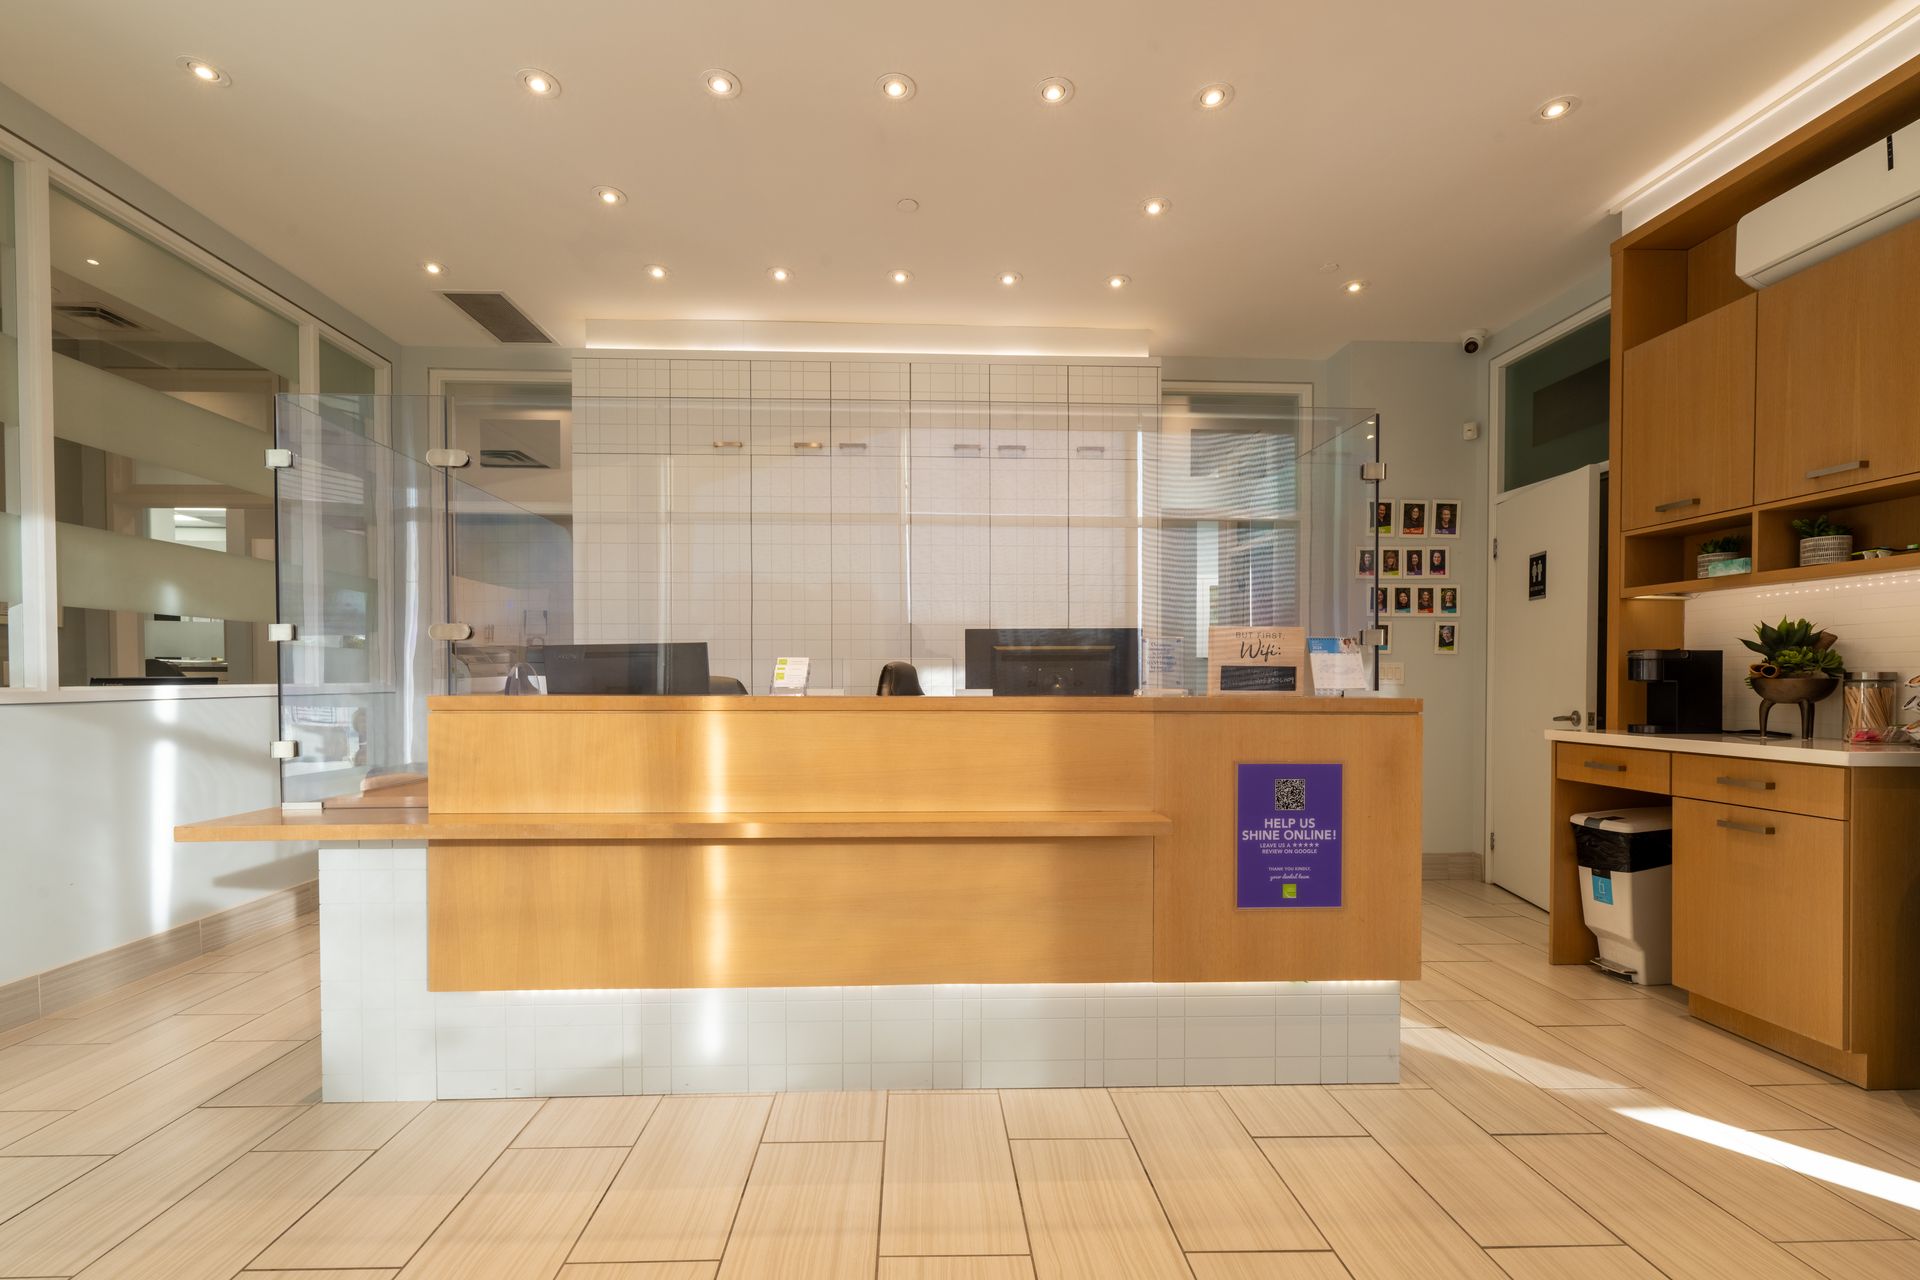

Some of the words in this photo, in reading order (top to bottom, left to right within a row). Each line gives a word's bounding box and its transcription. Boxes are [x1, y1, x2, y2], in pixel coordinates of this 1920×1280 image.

[1235, 631, 1253, 639] BUT
[1240, 639, 1281, 662] Wifi:
[1264, 818, 1296, 828] HELP
[1299, 818, 1315, 828] US
[1242, 830, 1280, 840] SHINE
[1284, 830, 1337, 840] ONLINE!
